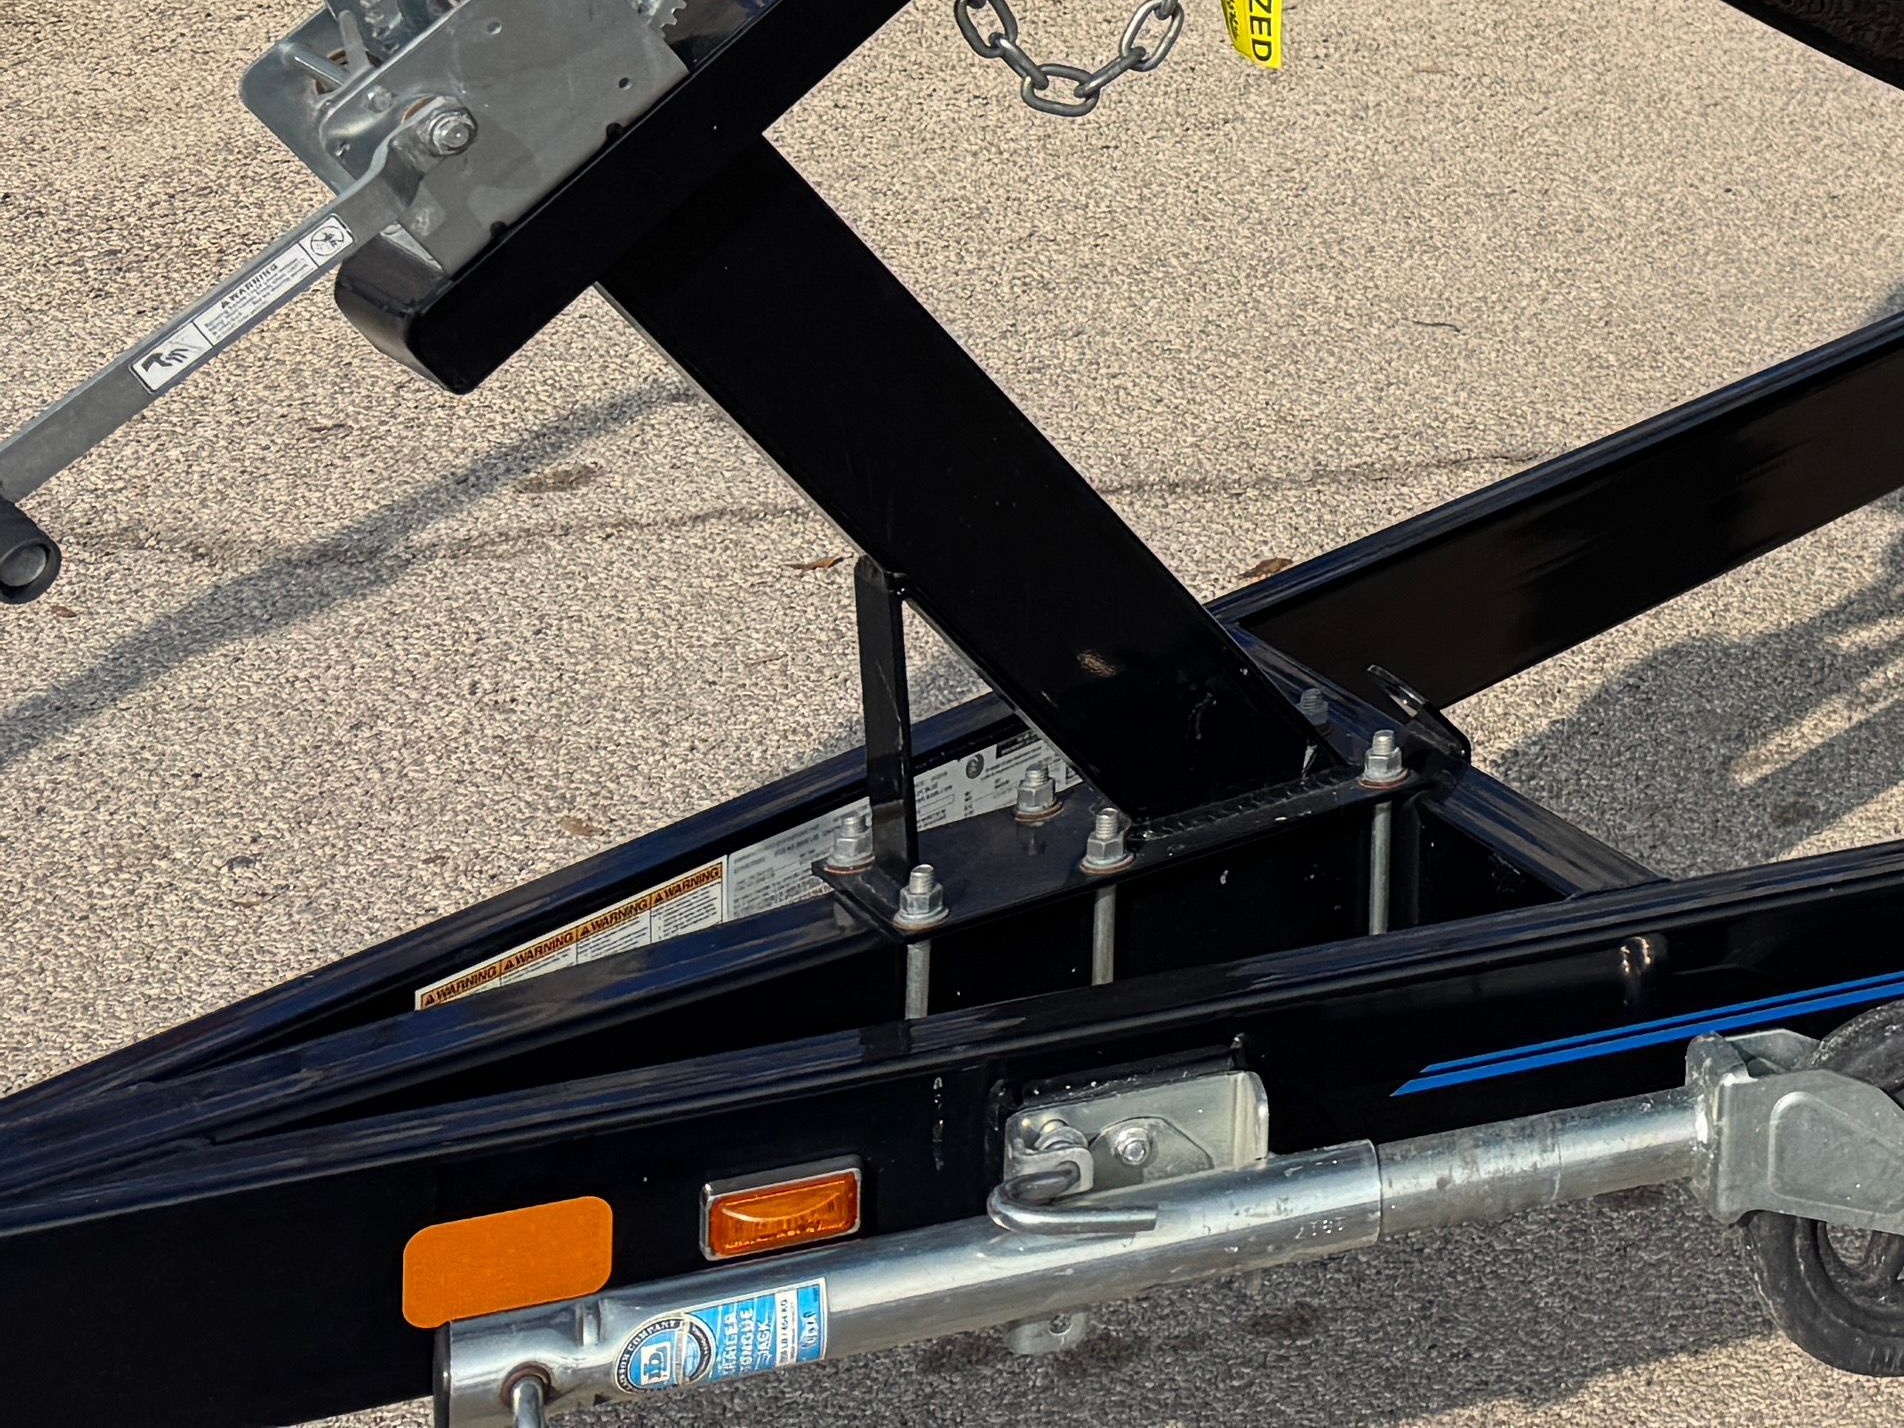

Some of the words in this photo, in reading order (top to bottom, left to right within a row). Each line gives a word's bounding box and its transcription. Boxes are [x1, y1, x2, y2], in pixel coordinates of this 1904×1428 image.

[229, 264, 278, 301] WARNING
[661, 866, 720, 901] WARNING
[590, 899, 649, 936] WARNING
[514, 931, 575, 971] WARNING
[436, 965, 498, 1005] WARNING
